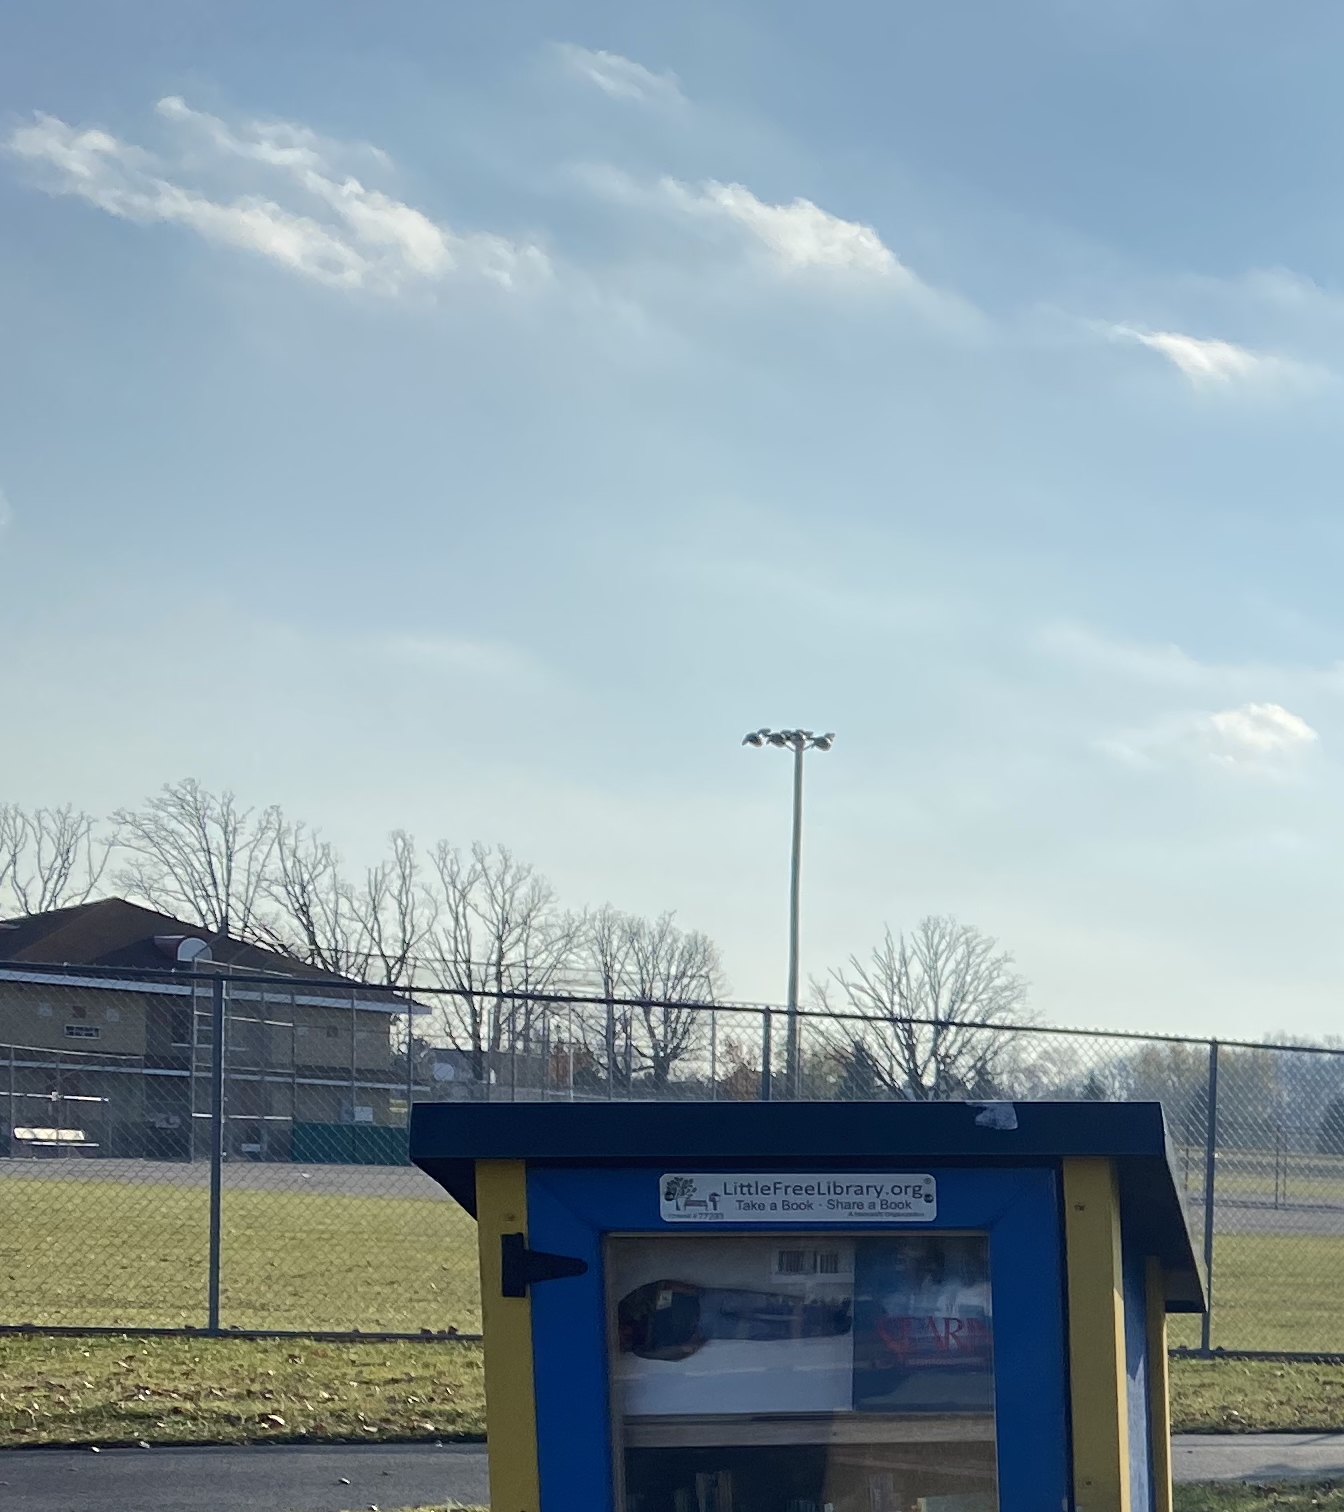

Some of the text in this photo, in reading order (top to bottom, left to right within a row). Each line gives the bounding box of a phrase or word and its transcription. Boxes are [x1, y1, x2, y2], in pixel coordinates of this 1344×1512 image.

[723, 1181, 923, 1199] LittleFreeLibrary.org
[735, 1198, 913, 1211] Take a Book Share a Book
